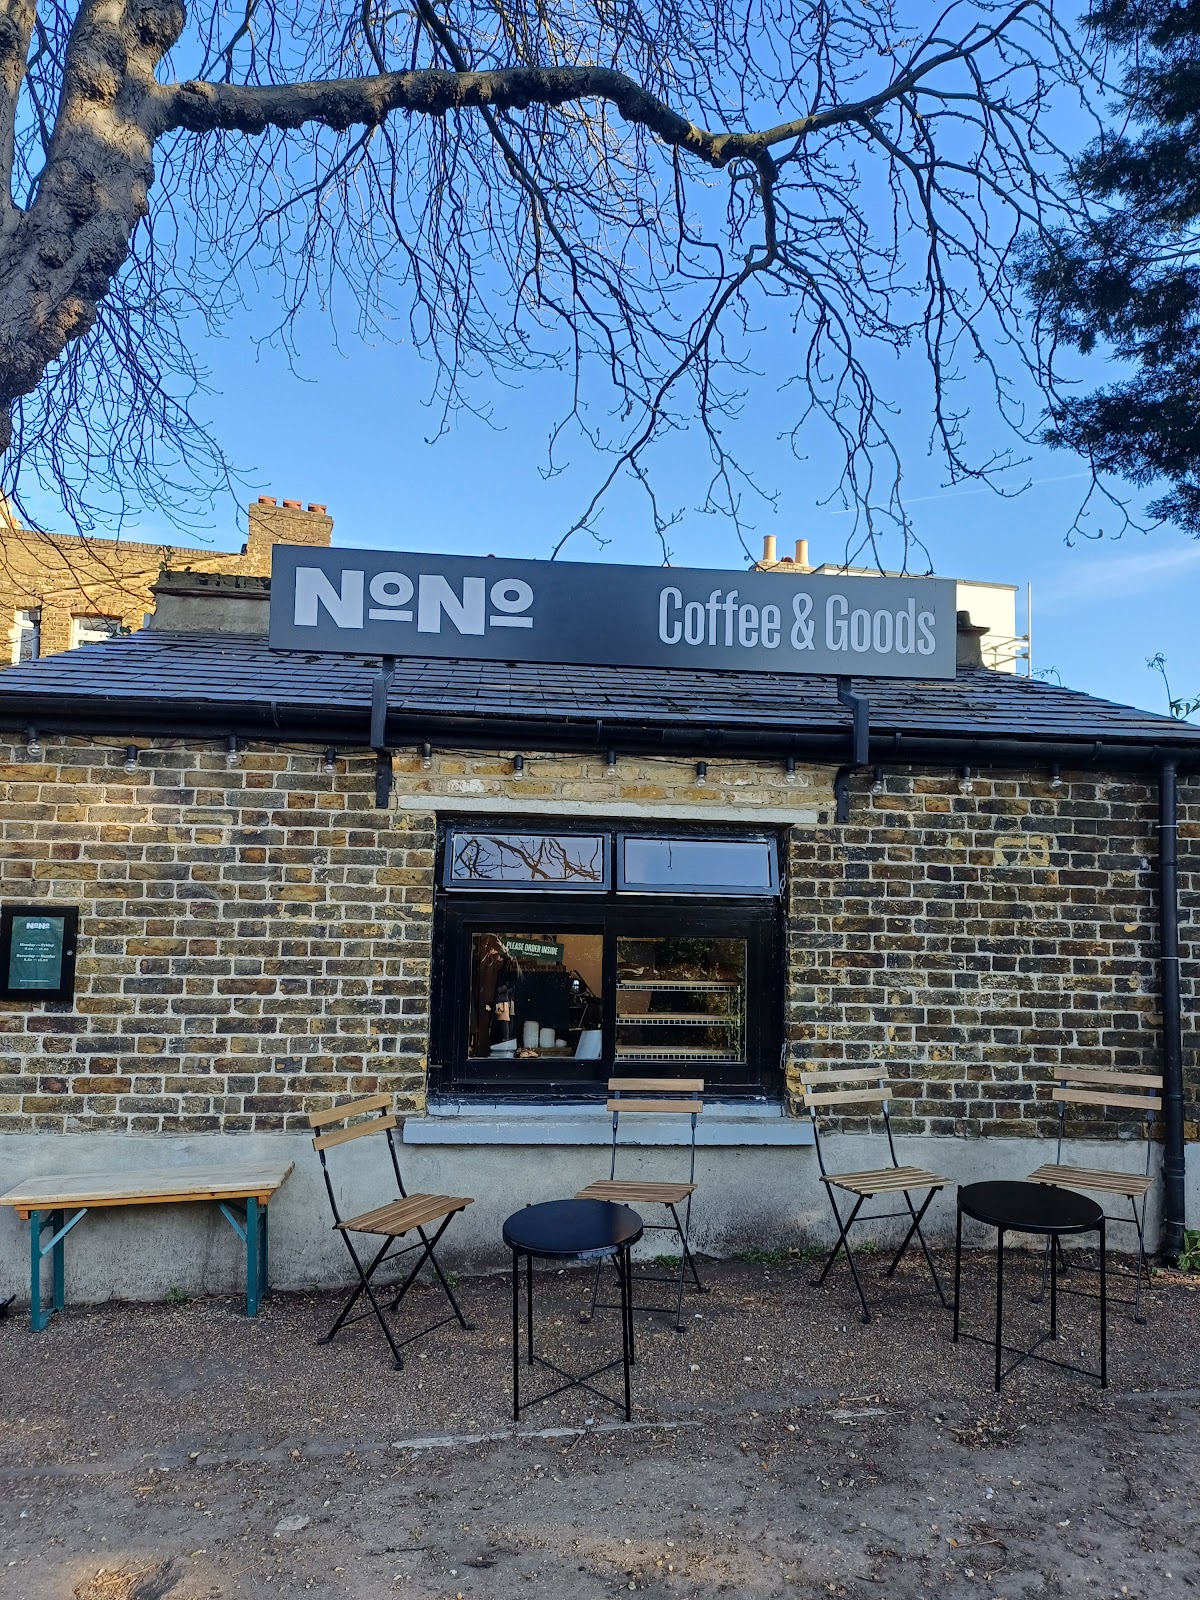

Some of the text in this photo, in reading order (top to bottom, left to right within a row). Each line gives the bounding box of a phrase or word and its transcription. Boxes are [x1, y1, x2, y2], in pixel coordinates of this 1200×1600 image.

[658, 586, 936, 656] Coffee & Goods
[506, 941, 558, 956] PLEASE ORDER INSIDE
